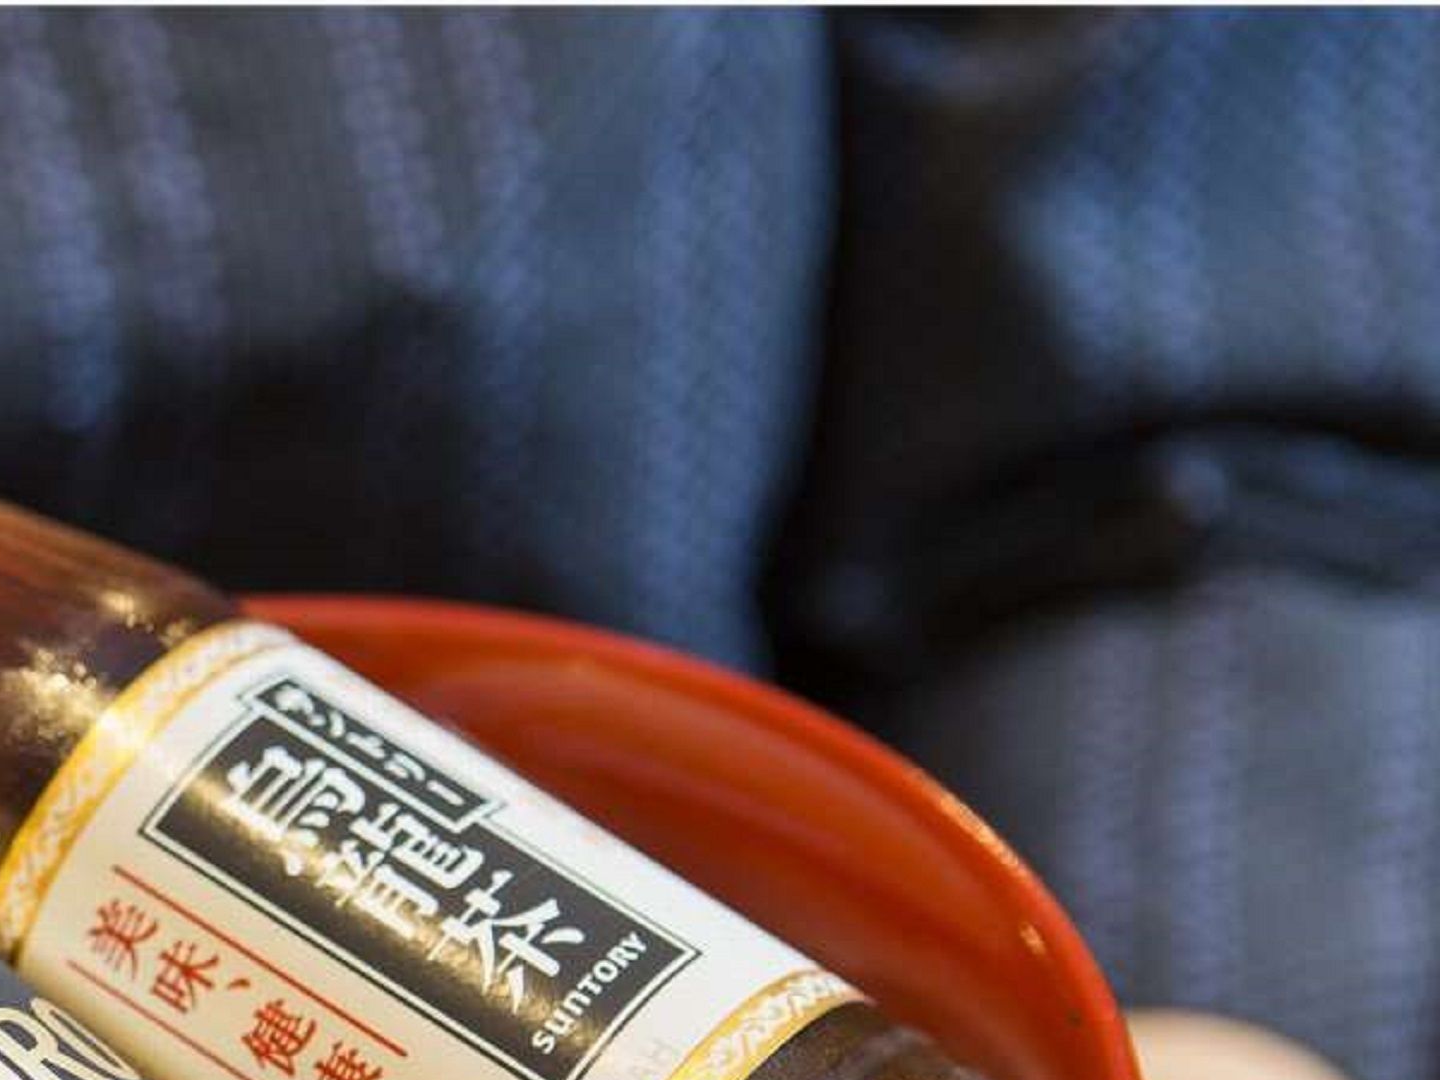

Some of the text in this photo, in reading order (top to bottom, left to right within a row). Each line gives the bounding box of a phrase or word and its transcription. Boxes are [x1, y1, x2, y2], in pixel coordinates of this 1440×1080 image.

[228, 745, 585, 1015] 烏龍茶
[531, 931, 649, 1054] SUNTORY
